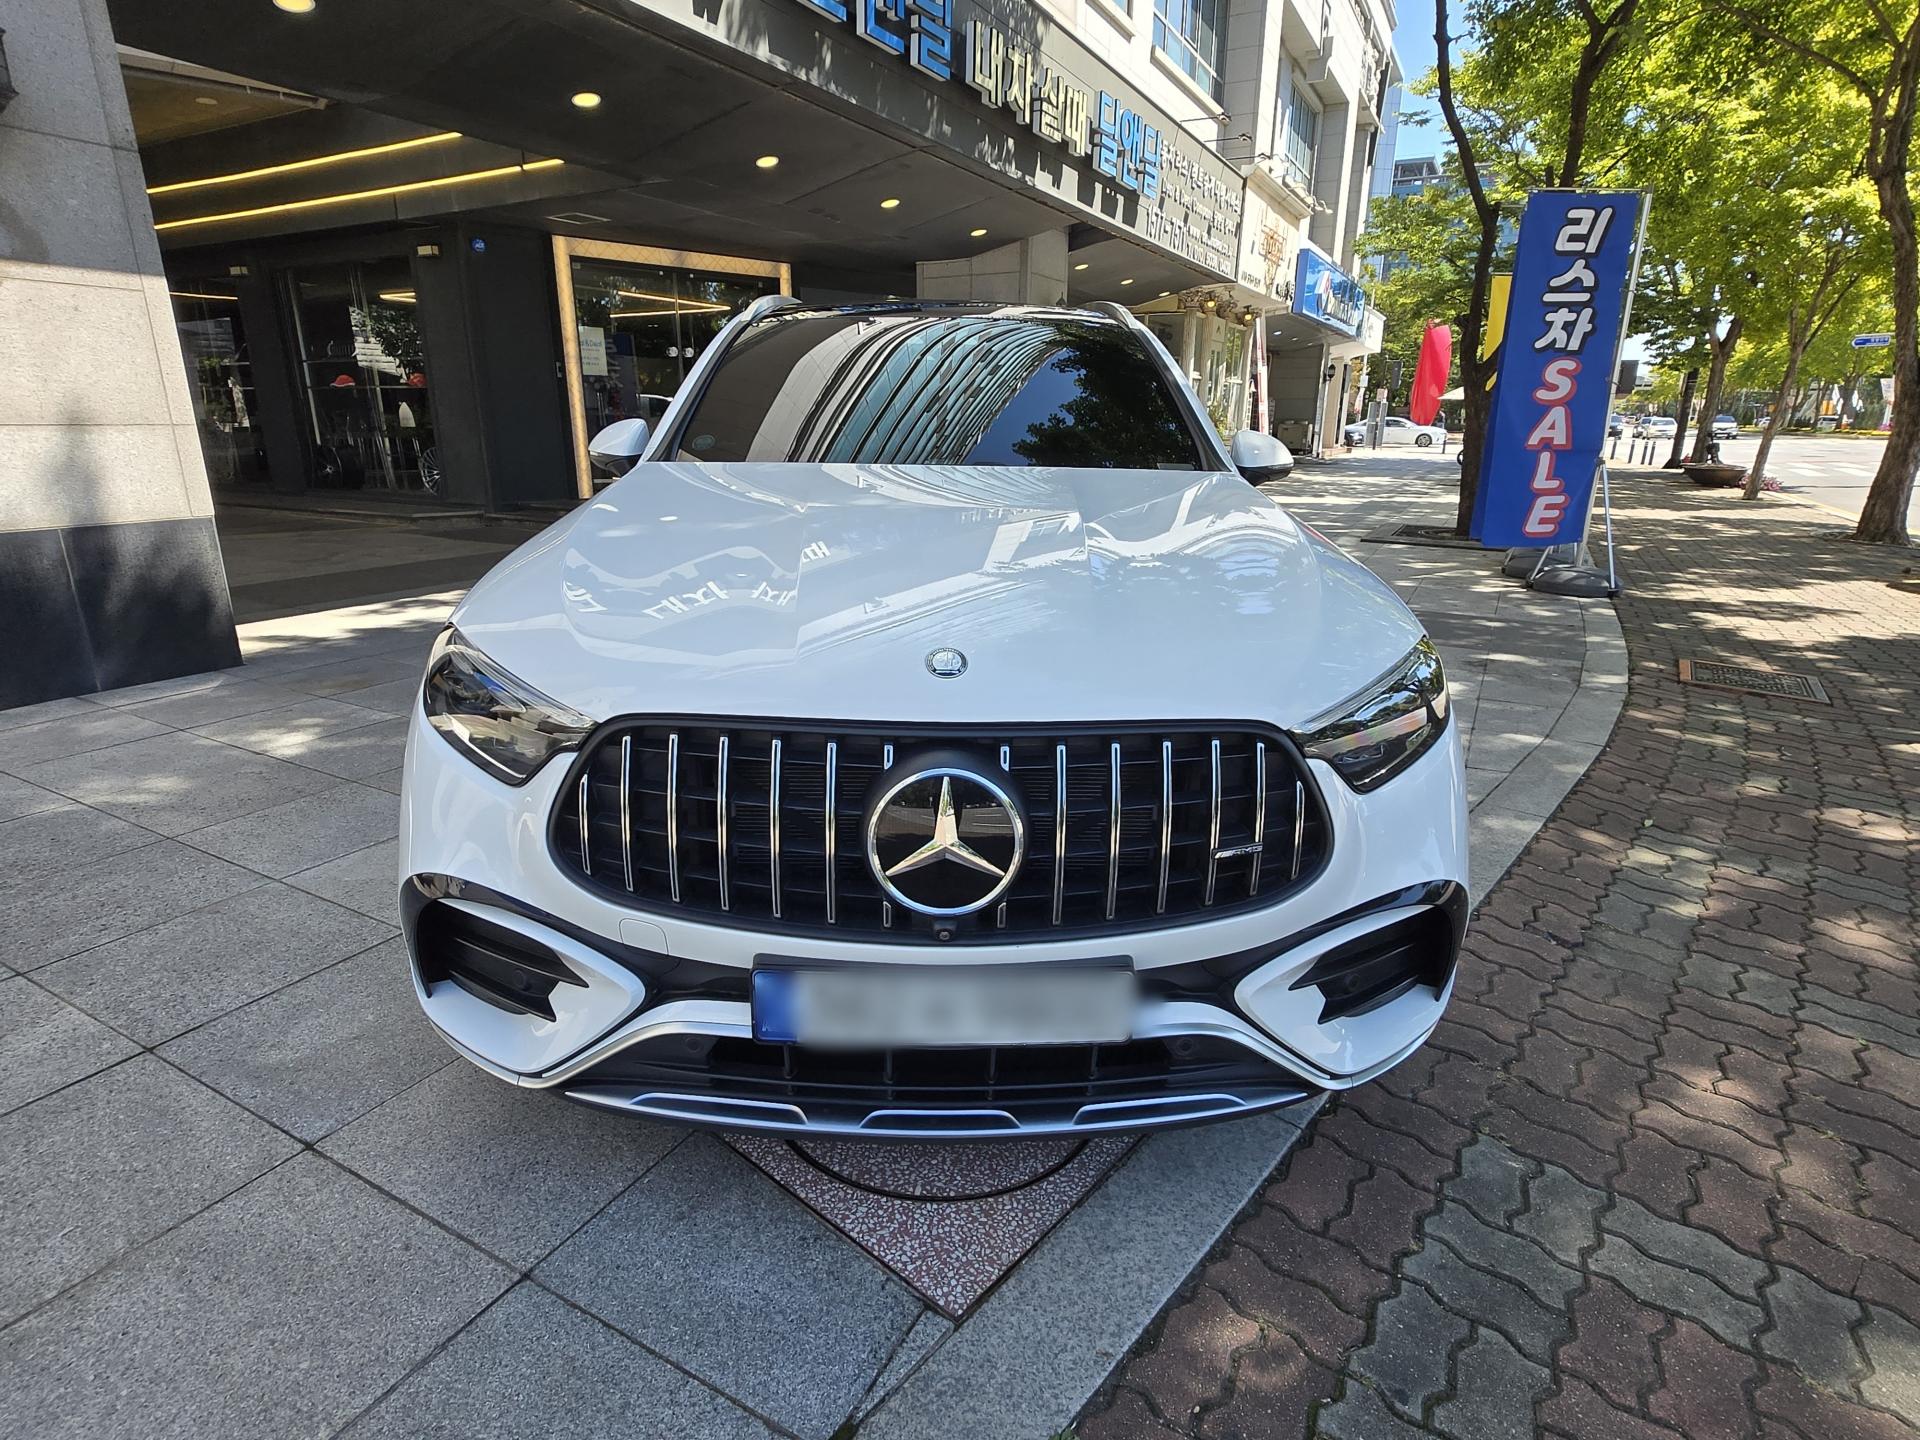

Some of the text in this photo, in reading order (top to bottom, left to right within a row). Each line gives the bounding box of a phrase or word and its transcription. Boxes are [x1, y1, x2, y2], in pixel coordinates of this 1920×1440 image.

[967, 20, 1087, 156] 내차살때
[1095, 90, 1161, 199] 딜앤딜
[1522, 206, 1614, 537] 리스차 SALE
